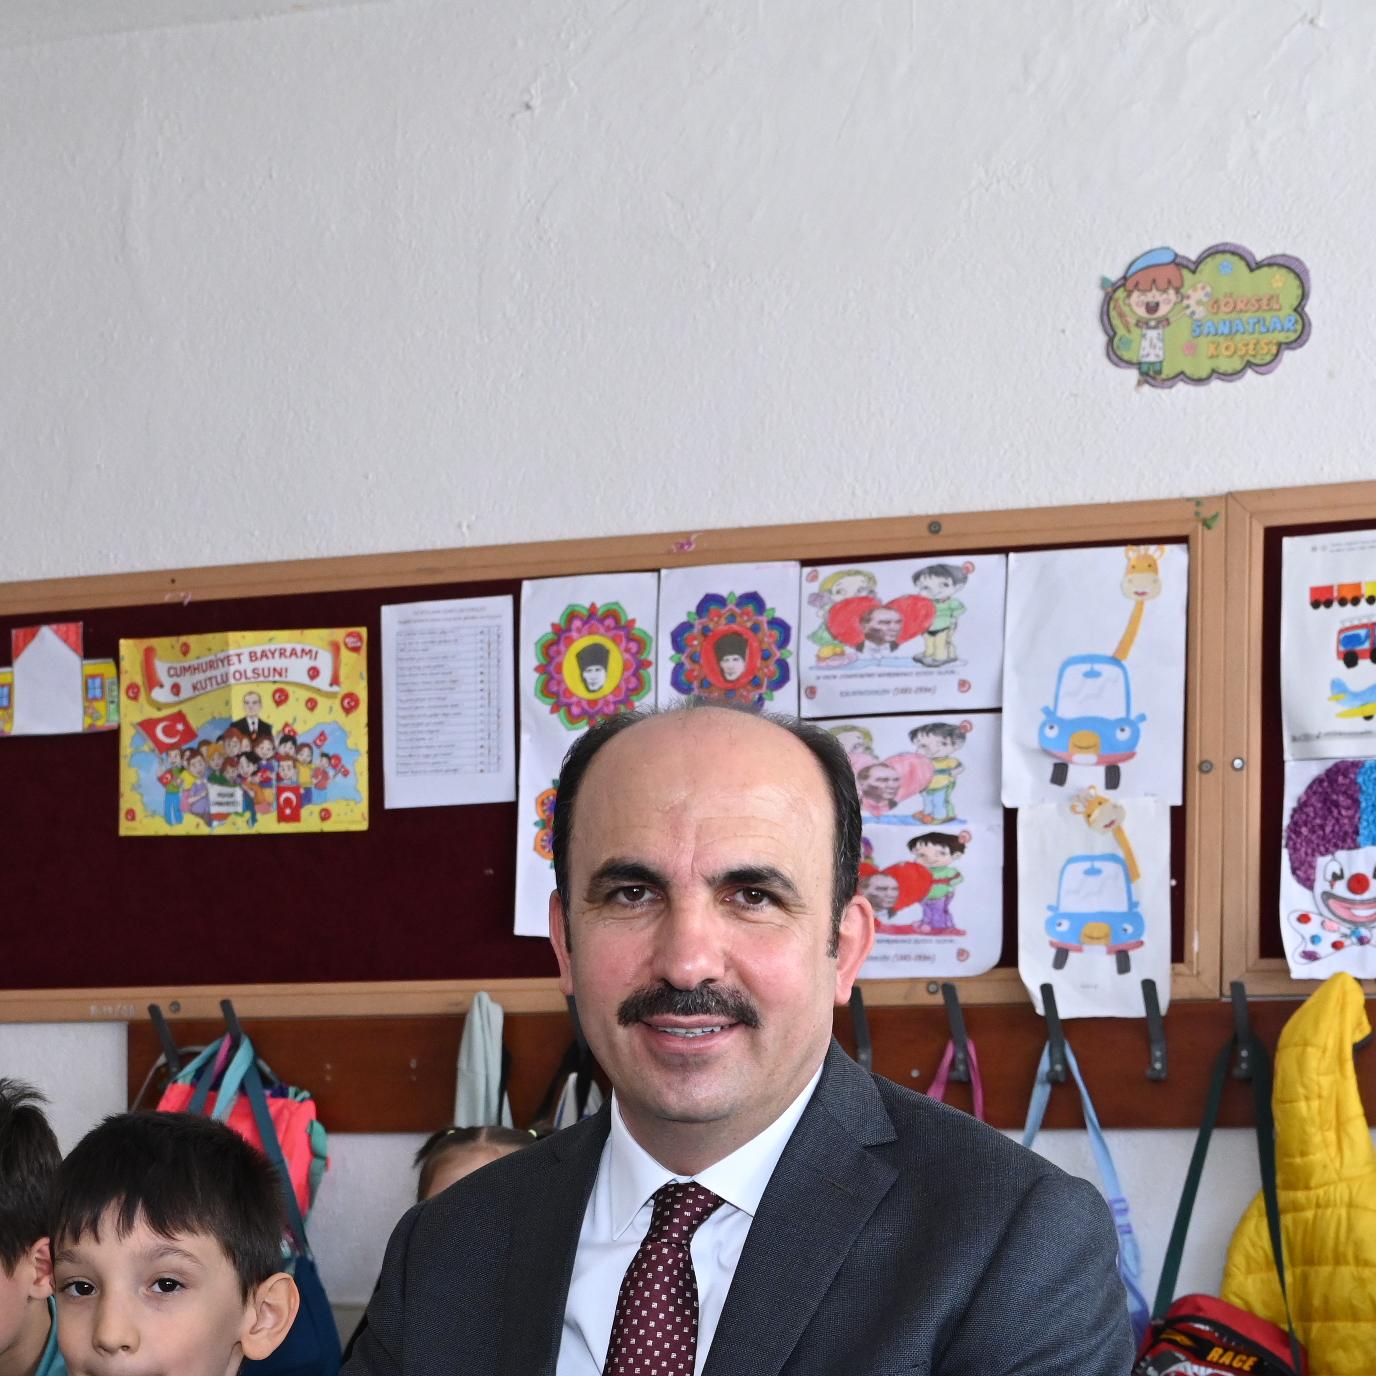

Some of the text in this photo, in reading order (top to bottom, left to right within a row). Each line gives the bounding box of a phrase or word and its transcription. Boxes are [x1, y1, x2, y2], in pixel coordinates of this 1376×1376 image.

[1192, 315, 1297, 337] SANATLAR
[167, 647, 319, 678] CUMHURİYET BAYRAMI
[191, 667, 289, 693] KUTLU OLSUN!
[1206, 1347, 1259, 1372] RACE
